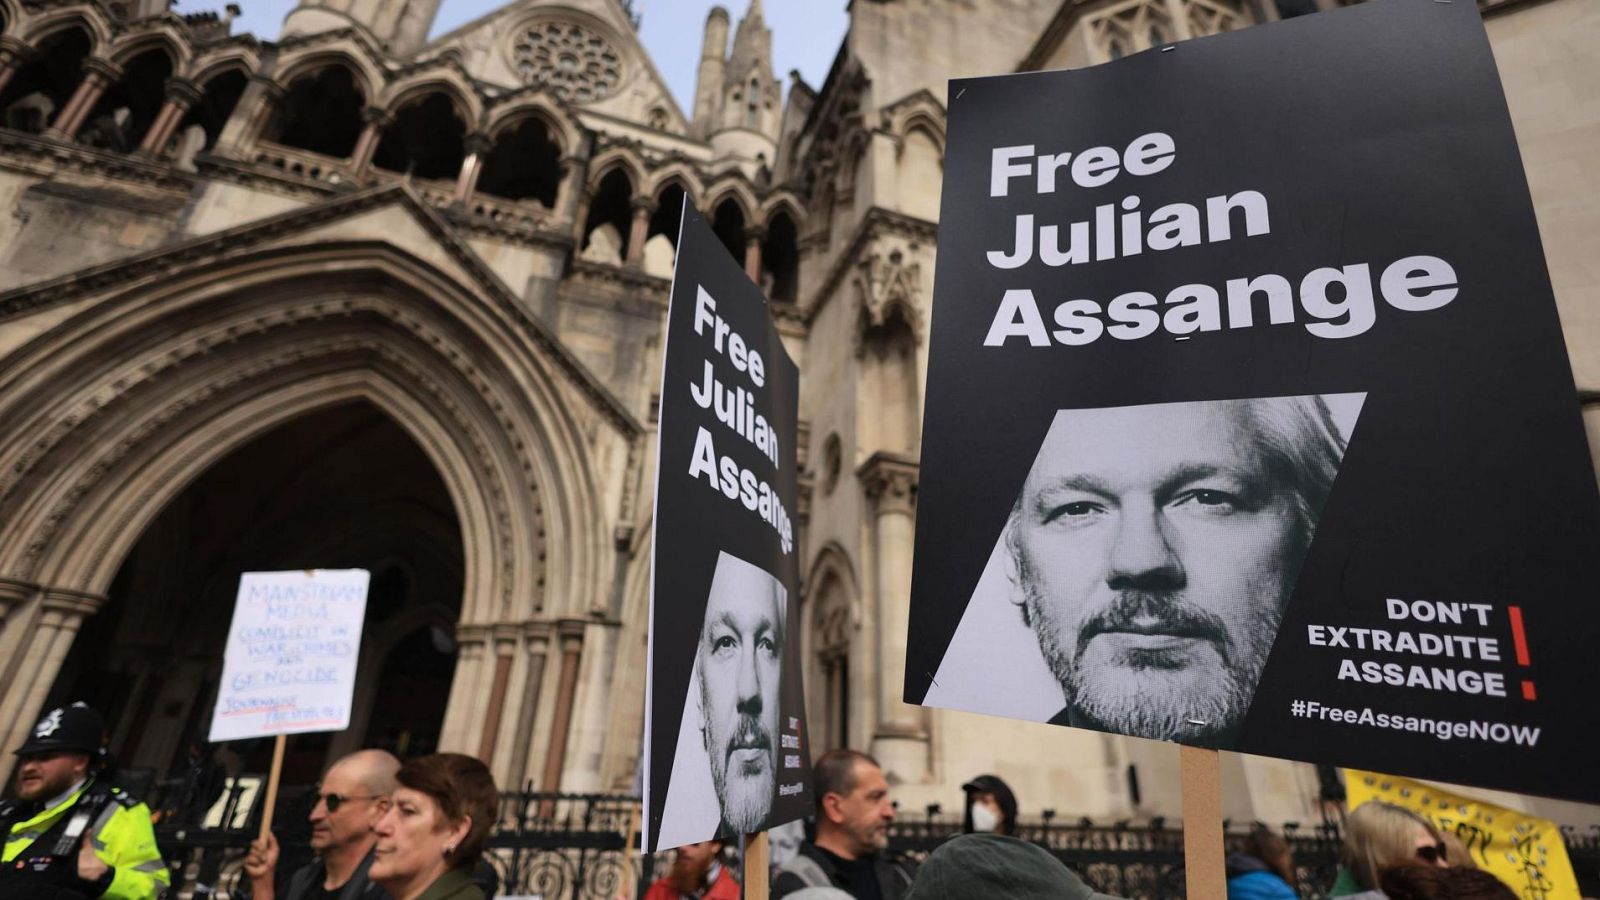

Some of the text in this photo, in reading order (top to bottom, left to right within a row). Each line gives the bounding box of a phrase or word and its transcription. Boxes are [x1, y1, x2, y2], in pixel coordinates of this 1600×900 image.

[991, 132, 1176, 197] Free
[986, 190, 1270, 269] Julian
[694, 284, 765, 388] Free
[983, 255, 1459, 347] Assange
[690, 359, 779, 470] Julian
[688, 426, 793, 555] Assange
[1308, 625, 1501, 661] EXTRADITE
[1386, 598, 1493, 626] DON'T
[1337, 659, 1507, 697] ASSANGE
[1291, 700, 1540, 746] #FreeAssangeNOW
